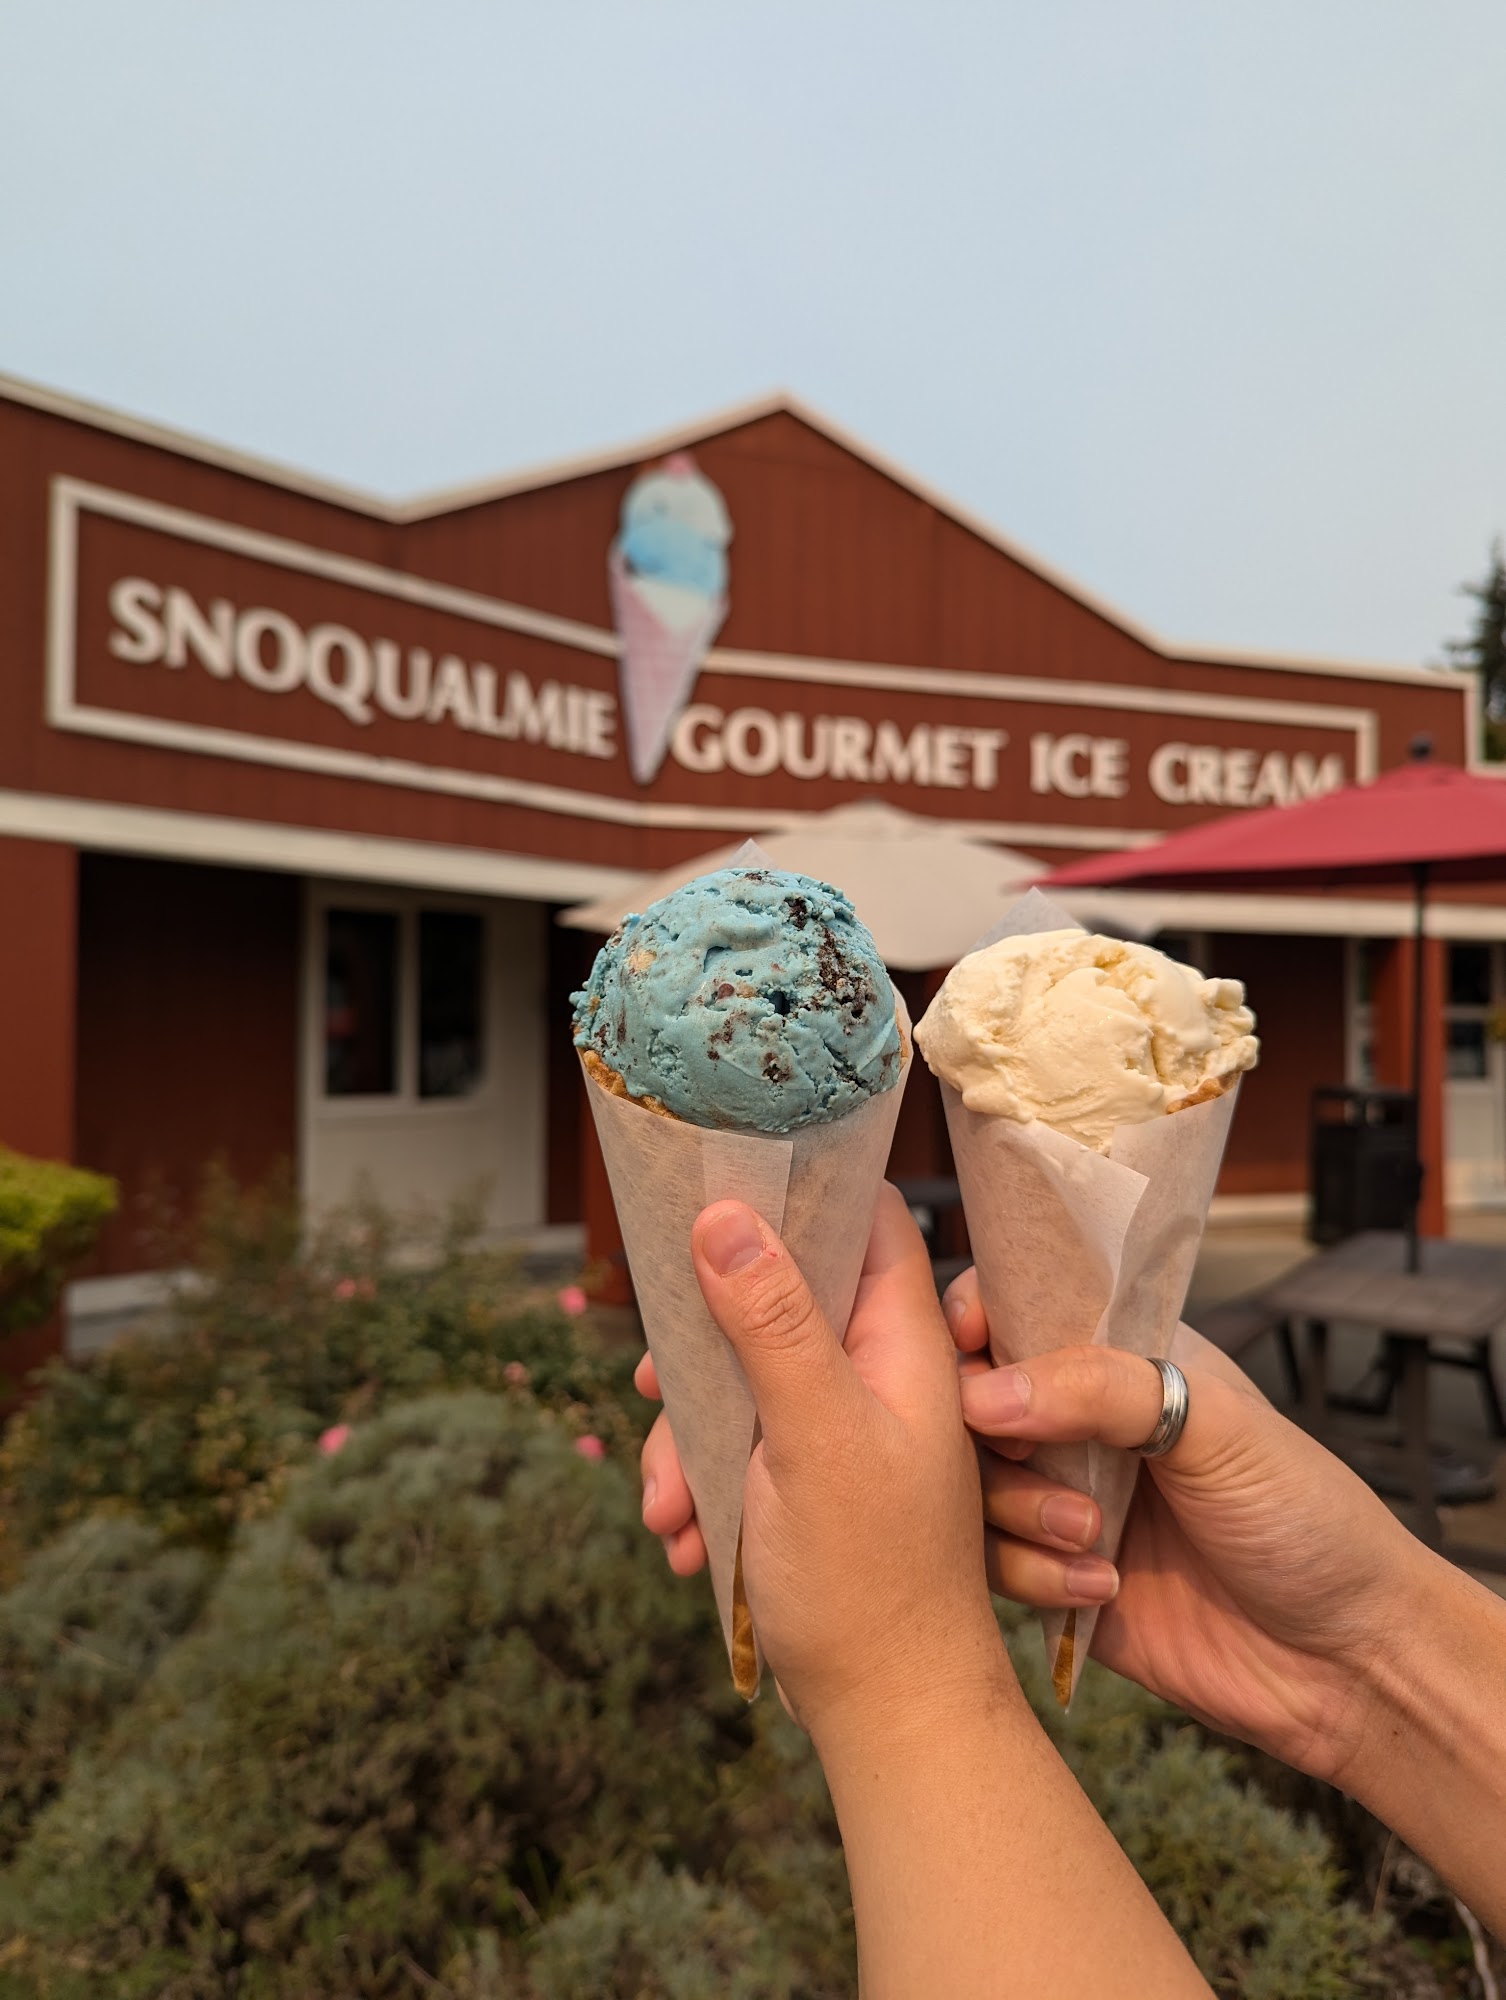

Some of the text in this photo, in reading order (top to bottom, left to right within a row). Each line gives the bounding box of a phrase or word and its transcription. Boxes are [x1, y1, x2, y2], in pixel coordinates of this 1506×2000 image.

[109, 577, 1343, 809] SNOQUALMIE GOURMET ICE CREAM
